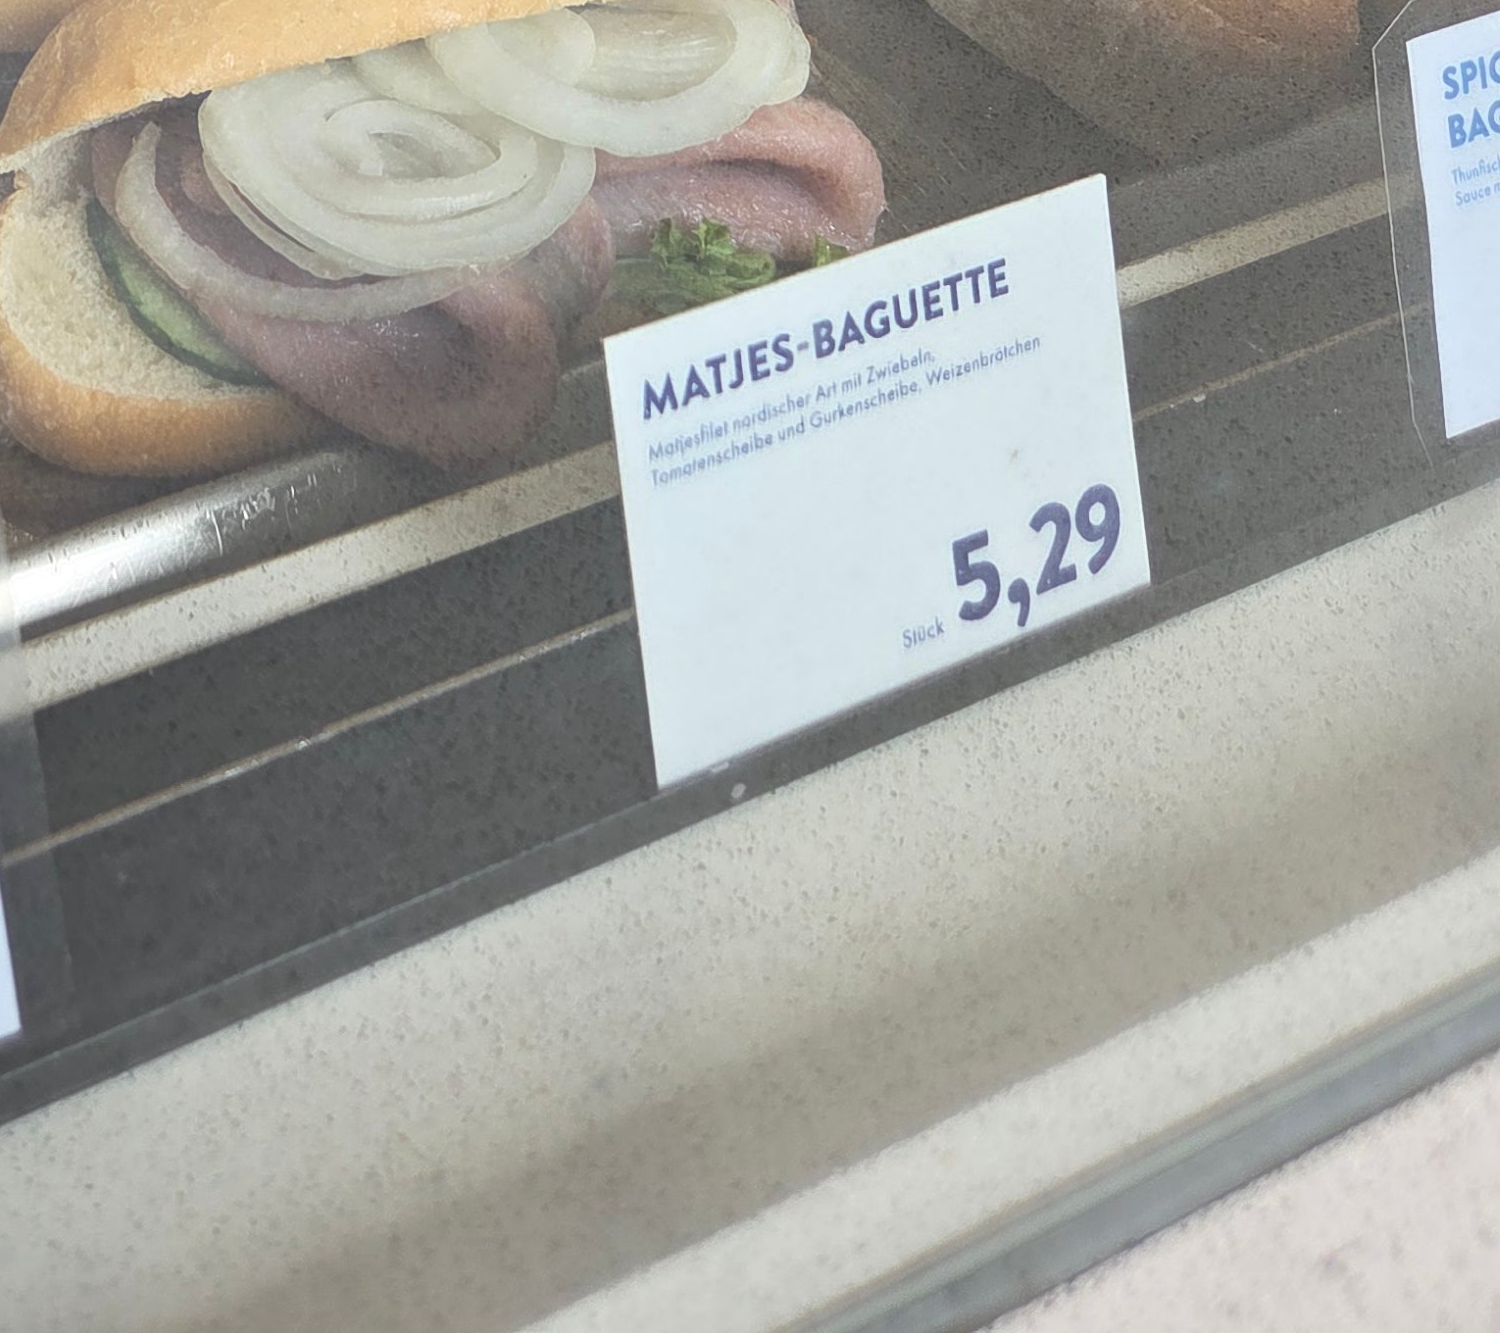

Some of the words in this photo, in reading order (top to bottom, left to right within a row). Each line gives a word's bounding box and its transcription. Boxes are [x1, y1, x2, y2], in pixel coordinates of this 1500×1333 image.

[1452, 152, 1500, 185] Thunfisc
[1455, 185, 1492, 207] Sauce
[642, 257, 1010, 420] MATJES-BAGUETTE
[648, 421, 729, 463] Matjesfilet
[732, 392, 811, 434] nordischer
[815, 380, 838, 402] Art
[841, 372, 864, 394] mit
[651, 432, 774, 488] Tomatenscheibe
[777, 419, 806, 442] und
[809, 380, 923, 430] Gurkenscheibe,
[925, 333, 1042, 387] Weizenbrötchen
[902, 615, 946, 649] Stück
[951, 483, 1121, 628] 5,29
